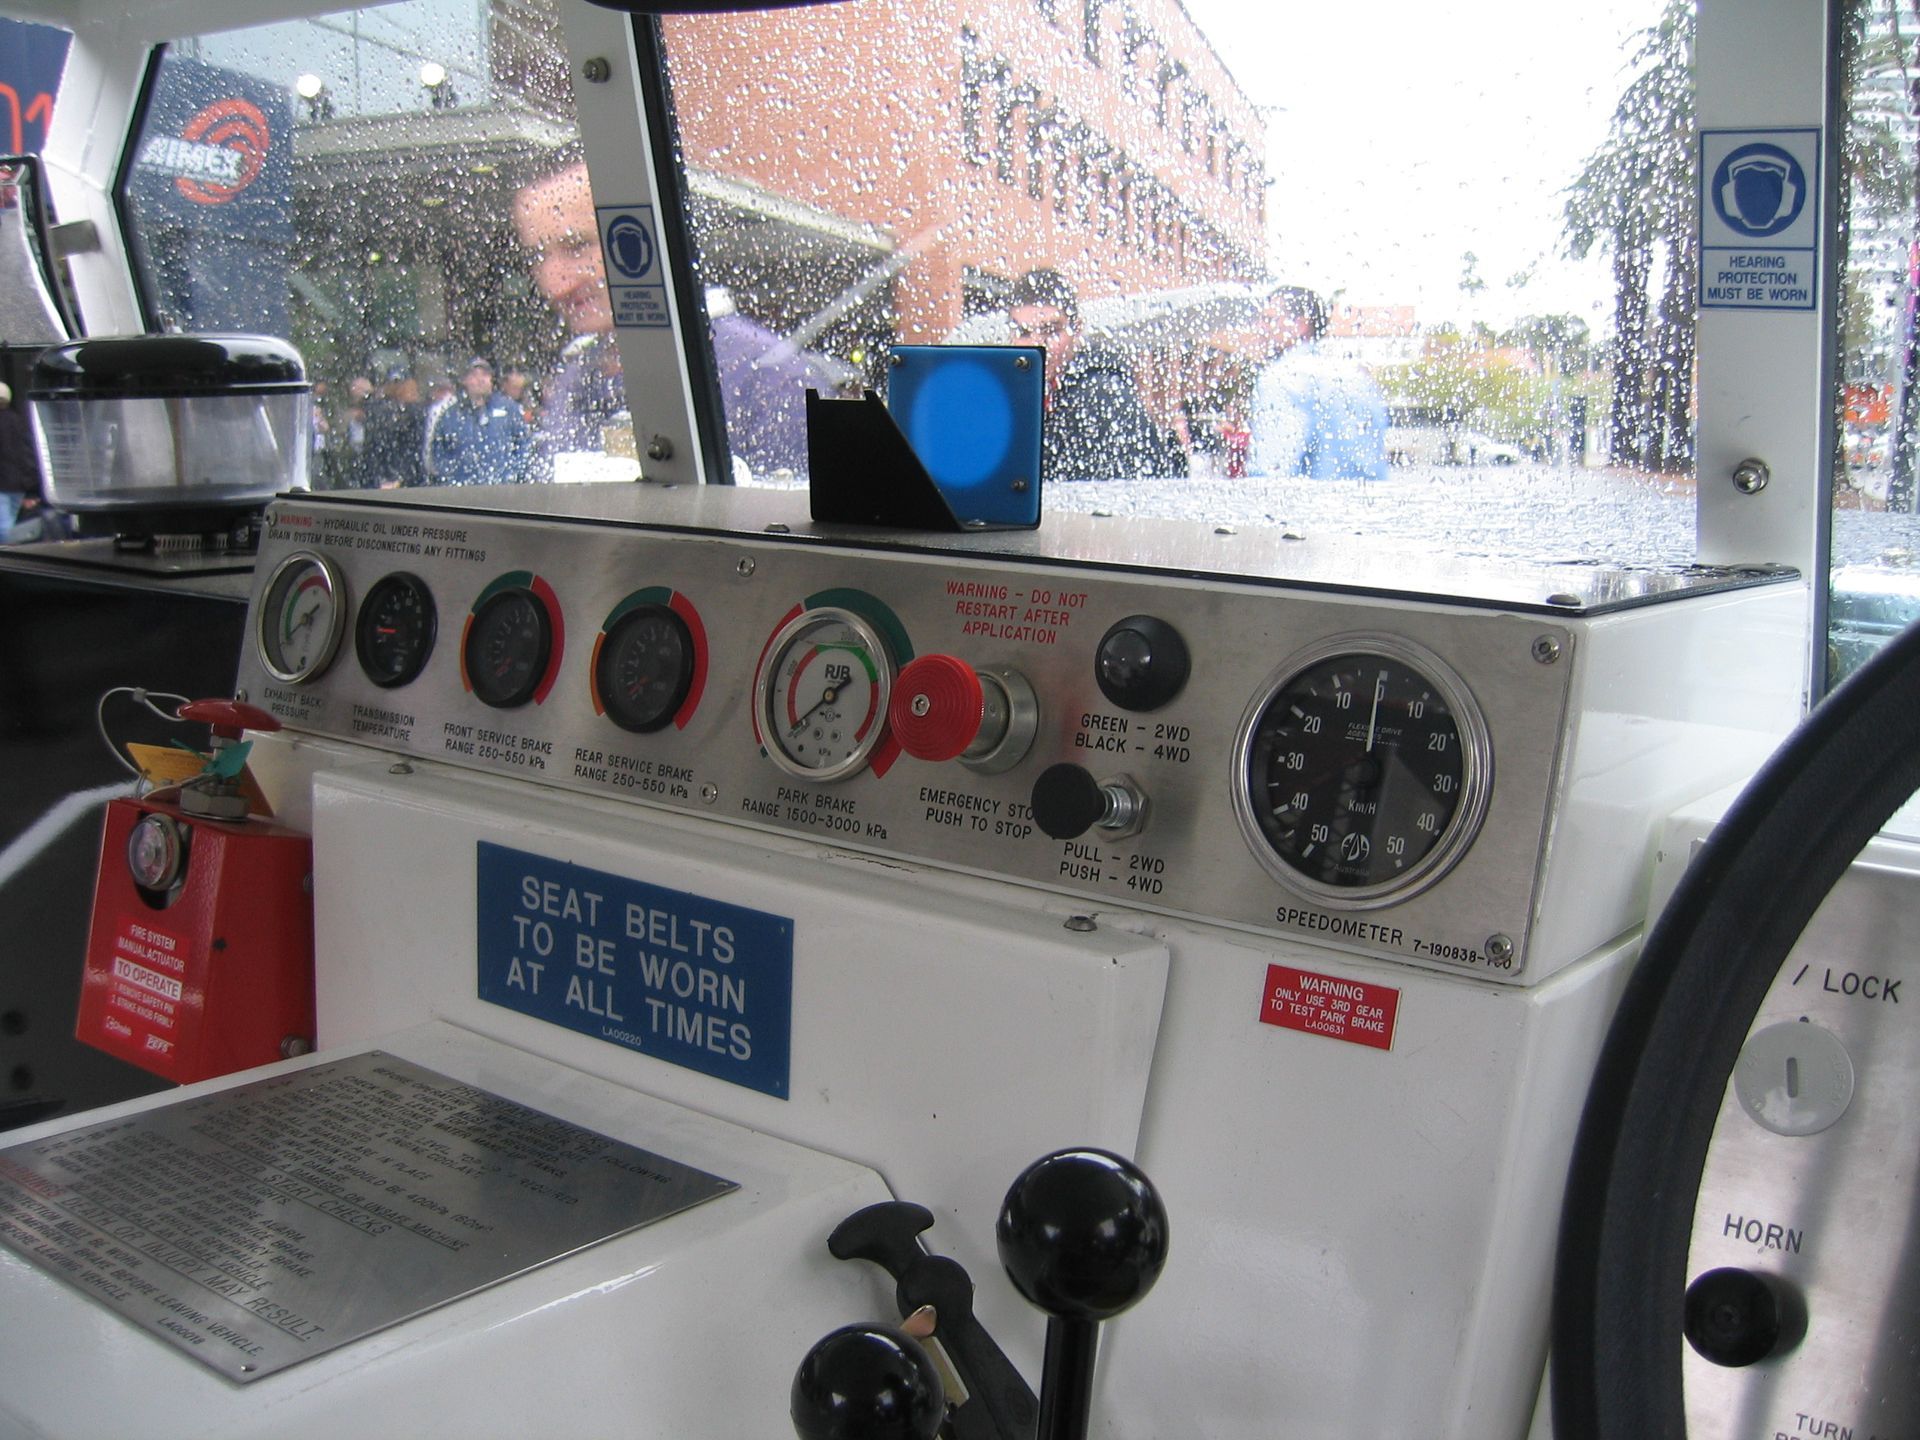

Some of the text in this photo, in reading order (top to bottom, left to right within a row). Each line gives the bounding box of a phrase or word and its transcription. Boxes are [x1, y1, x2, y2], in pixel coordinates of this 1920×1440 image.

[1729, 256, 1785, 269] HEARING
[1718, 272, 1797, 284] PROTECTION
[1707, 288, 1807, 301] MUST BE WORN
[280, 514, 468, 542] WARNING HYDRAULIC OIL UNDER PRESSURE
[268, 528, 487, 562] DRAIN SYSTEM BEFORE DISCONNECTING ANY FITTINGS
[946, 581, 1088, 608] WARNING DO NOT
[956, 601, 1070, 626] RESTART AFTER
[963, 621, 1057, 644] APPLICATION
[264, 687, 322, 707] EXHAUST BACK
[271, 702, 309, 720] PRESSURE
[1335, 691, 1352, 710] 10
[1407, 700, 1424, 720] 10
[353, 704, 415, 728] TRANSMISSION
[1081, 713, 1191, 743] GREEN 2WD
[1303, 716, 1321, 735] 20
[352, 719, 411, 742] TEMPERATURE
[444, 722, 553, 755] FRONT SERVICE BRAKE
[1427, 732, 1446, 752] 20
[445, 738, 546, 770] RANGE 250-550 kPa
[1075, 732, 1191, 764] BLACK 4WD
[1286, 752, 1304, 771] 30
[575, 747, 694, 783] REAR SERVICE BRAKE
[574, 764, 689, 800] RANGE 250-550 kPa
[1433, 774, 1452, 793] 30
[777, 786, 856, 815] PARK BRAKE
[918, 787, 1034, 821] EMERGENCY STO
[1291, 792, 1309, 811] 40
[1348, 799, 1377, 816] Km/H
[742, 798, 888, 841] RANGE 1500-3000 kPa
[925, 807, 1032, 841] PUSH TO STOP
[1311, 824, 1329, 843] 50
[1416, 813, 1435, 832] 40
[1063, 841, 1165, 875] PULL 2WD
[1386, 836, 1405, 856] 50
[1059, 861, 1163, 895] PUSH 4WD
[522, 875, 736, 965] SEAT BELTS
[130, 924, 176, 951] FIRE SYSTEM
[1275, 905, 1513, 970] SPEEDOMETER 7-190838-0
[118, 937, 186, 974] MANUAL ACTUATOR
[512, 914, 746, 1015] TO BE WORN
[117, 959, 131, 977] TO
[132, 963, 180, 998] OPERATE
[1298, 974, 1364, 1000] WARNING
[1823, 968, 1903, 1004] LOCK
[506, 956, 752, 1062] AT ALL TIMES
[1270, 998, 1385, 1034] TO TEST PARK BRAKE
[1275, 987, 1384, 1019] ONLY USE 3RD GEAR
[601, 1025, 643, 1047] LA00220
[1304, 1019, 1345, 1035] LA00631
[264, 1173, 321, 1200] START
[318, 1201, 393, 1234] CHECKS
[56, 1220, 93, 1239] MUST
[88, 1238, 111, 1249] BE
[1722, 1213, 1804, 1255] HORN
[36, 1244, 83, 1270] LEAVING
[60, 1197, 117, 1226] DEATH
[114, 1226, 145, 1239] OR
[147, 1242, 208, 1276] INJURY
[203, 1274, 250, 1297] MAY
[244, 1297, 325, 1340] RESULT.
[74, 1248, 116, 1268] BRAKE
[110, 1269, 161, 1295] BEFORE
[154, 1295, 209, 1324] LEAVING
[157, 1317, 206, 1345] LA00018
[1795, 1412, 1854, 1440] TURN
